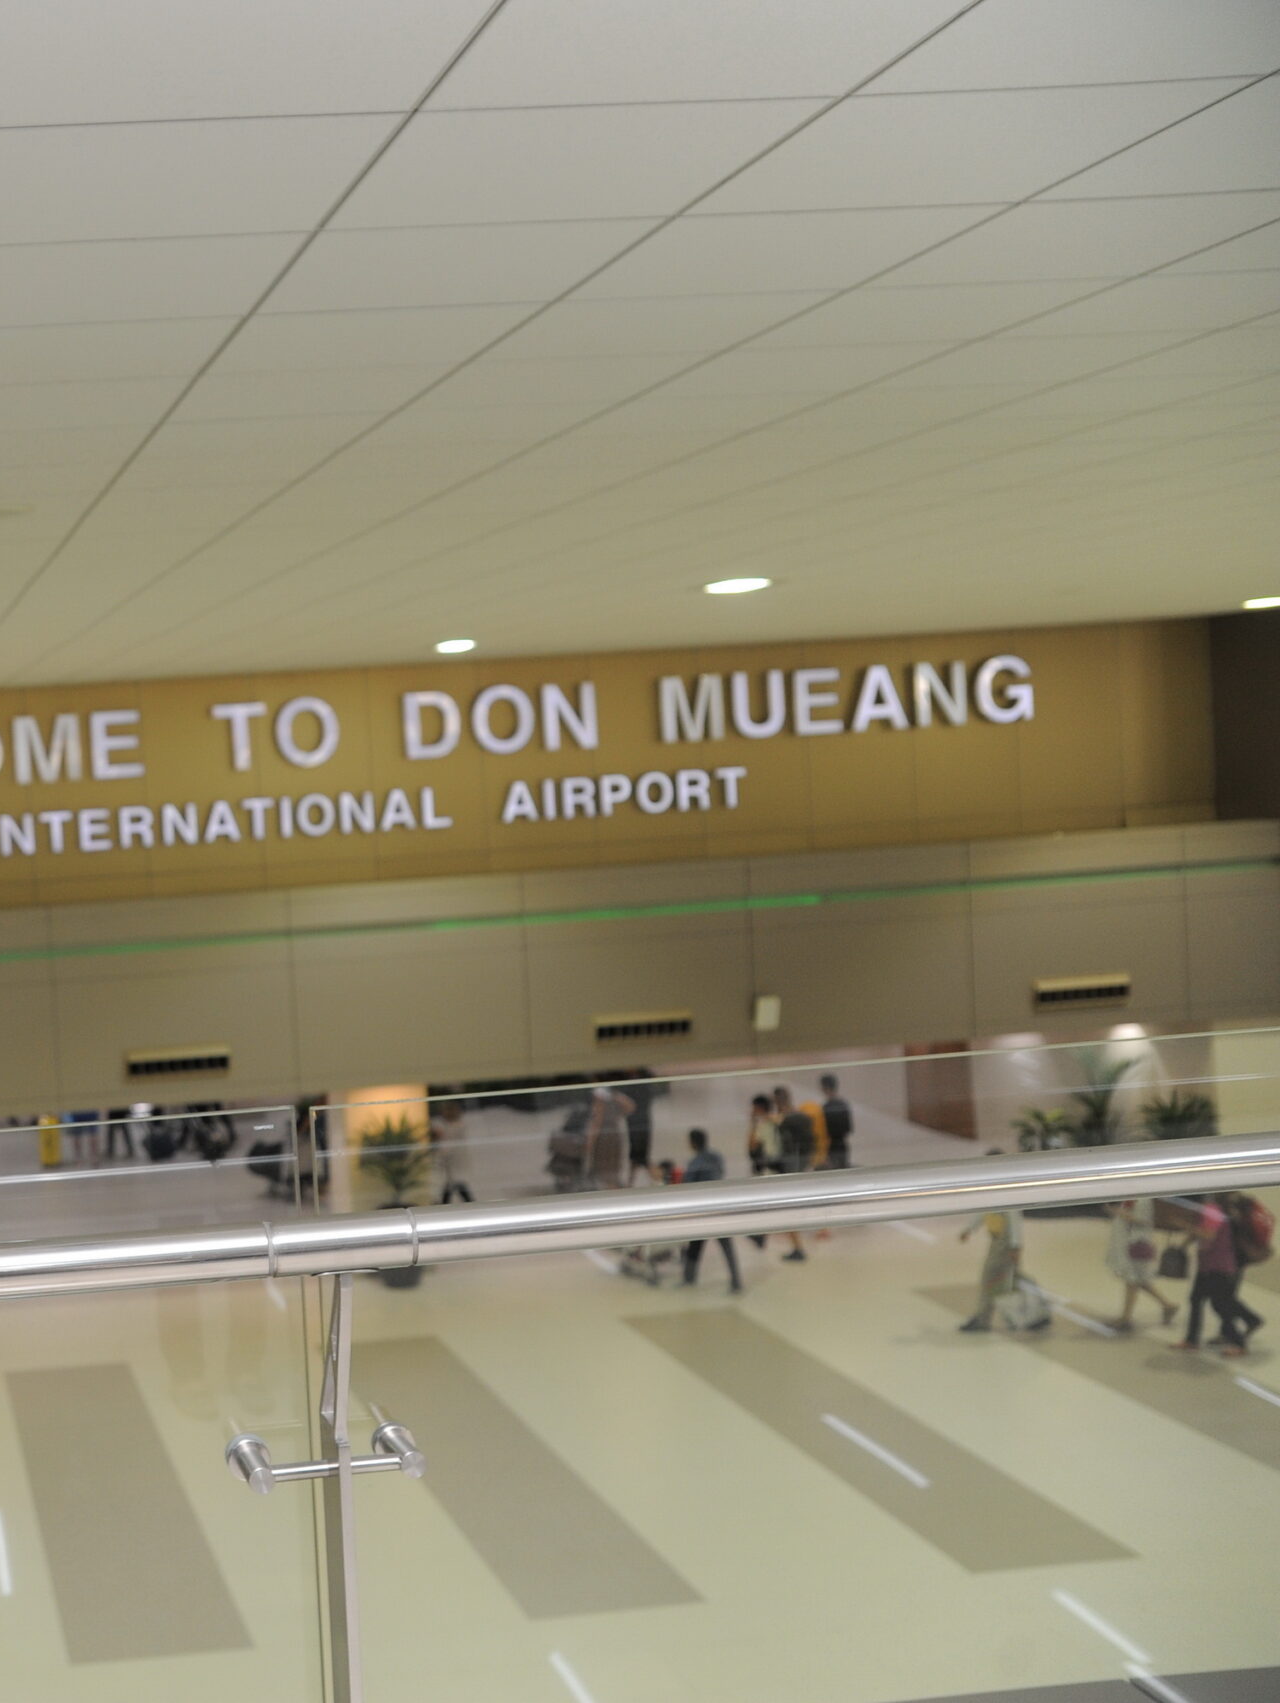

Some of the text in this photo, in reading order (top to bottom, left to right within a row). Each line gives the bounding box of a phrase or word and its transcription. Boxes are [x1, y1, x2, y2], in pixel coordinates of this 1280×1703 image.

[211, 697, 340, 771] TO
[402, 682, 599, 760] DON
[658, 654, 1035, 744] MUEANG
[501, 766, 748, 825] AIRPORT
